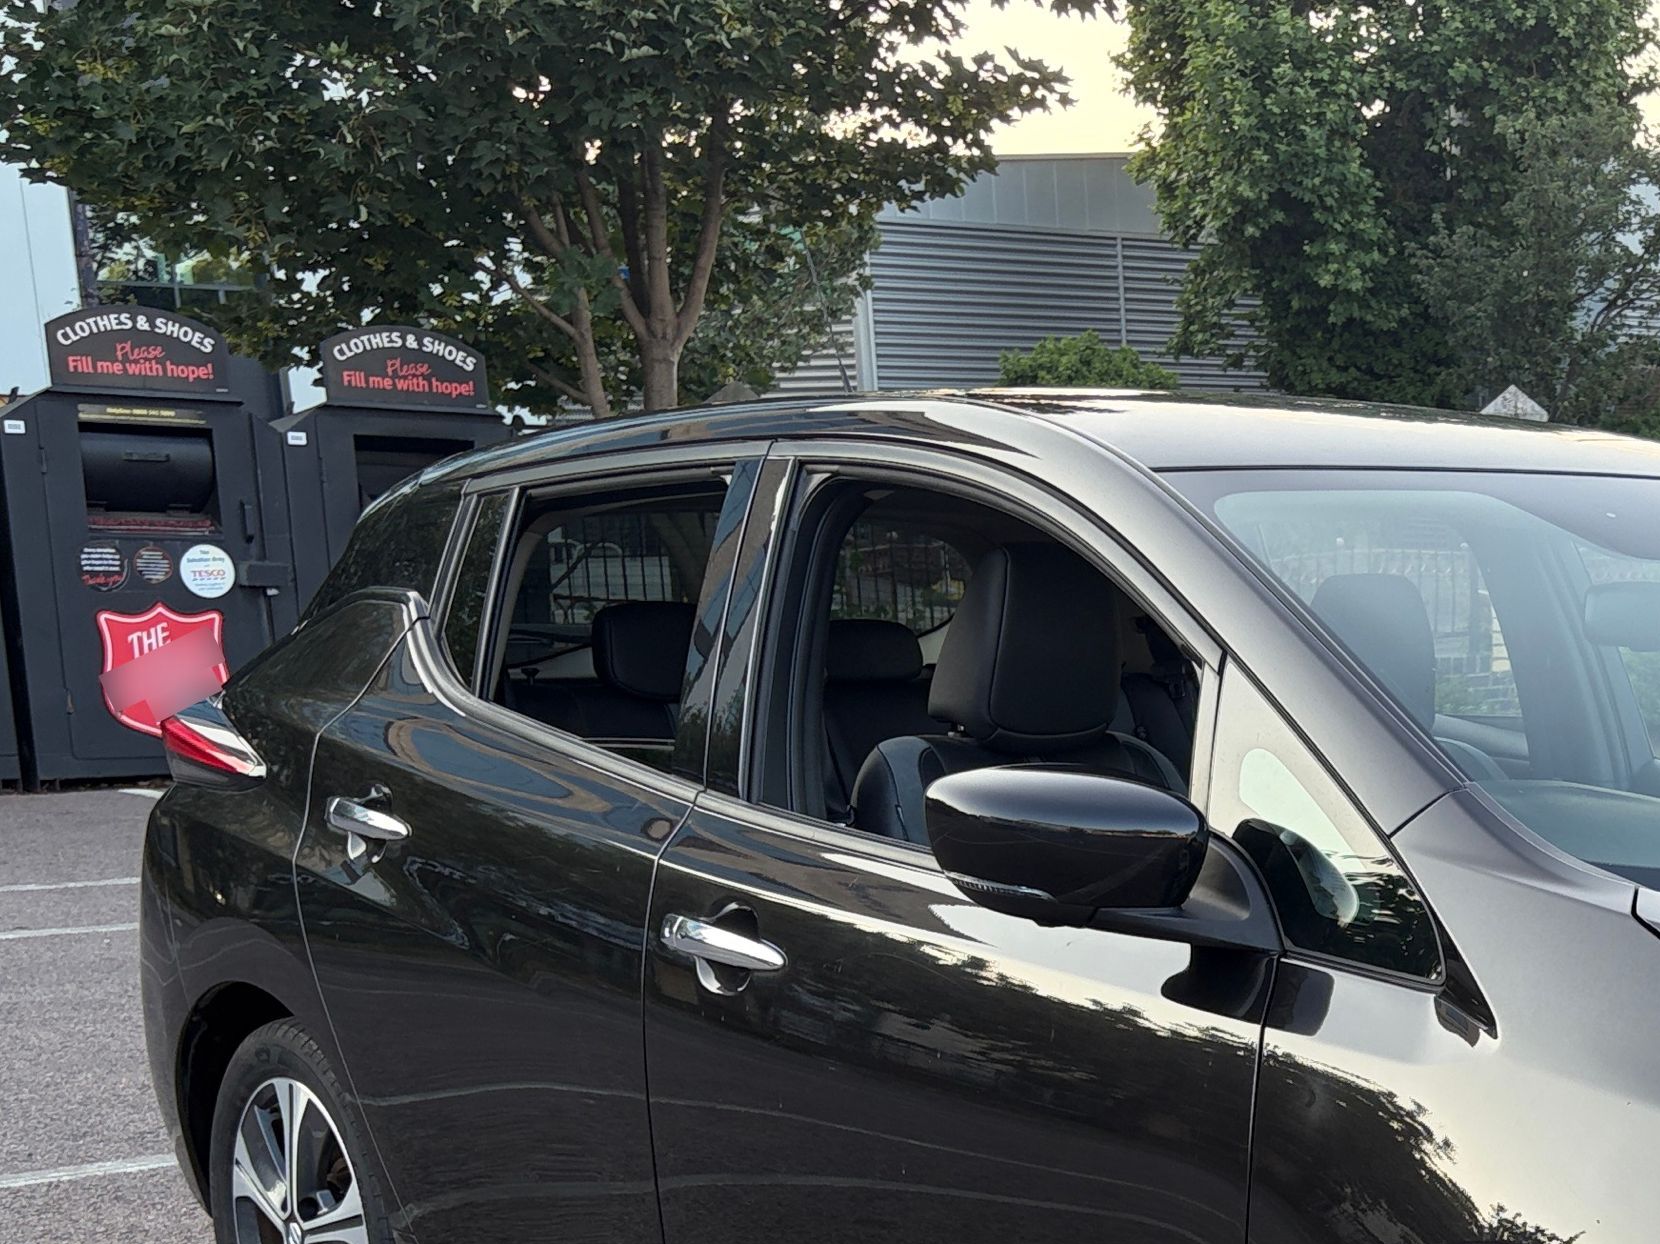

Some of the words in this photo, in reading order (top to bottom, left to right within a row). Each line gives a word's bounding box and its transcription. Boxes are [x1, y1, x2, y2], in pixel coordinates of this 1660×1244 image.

[56, 313, 133, 346] CLOTHES
[136, 315, 151, 331] &
[155, 317, 215, 354] SHOES
[115, 340, 166, 361] Please
[332, 331, 403, 361] CLOTHES
[405, 334, 419, 349] &
[422, 336, 477, 372] SHOES
[67, 355, 94, 374] Fill
[96, 360, 124, 375] me
[126, 358, 163, 377] with
[165, 360, 215, 383] hope!
[385, 357, 432, 377] Please
[342, 370, 367, 388] Fill
[368, 375, 394, 391] me
[395, 375, 430, 393] with
[431, 377, 476, 399] hope!
[190, 569, 226, 578] TESCO
[127, 621, 172, 660] THE
